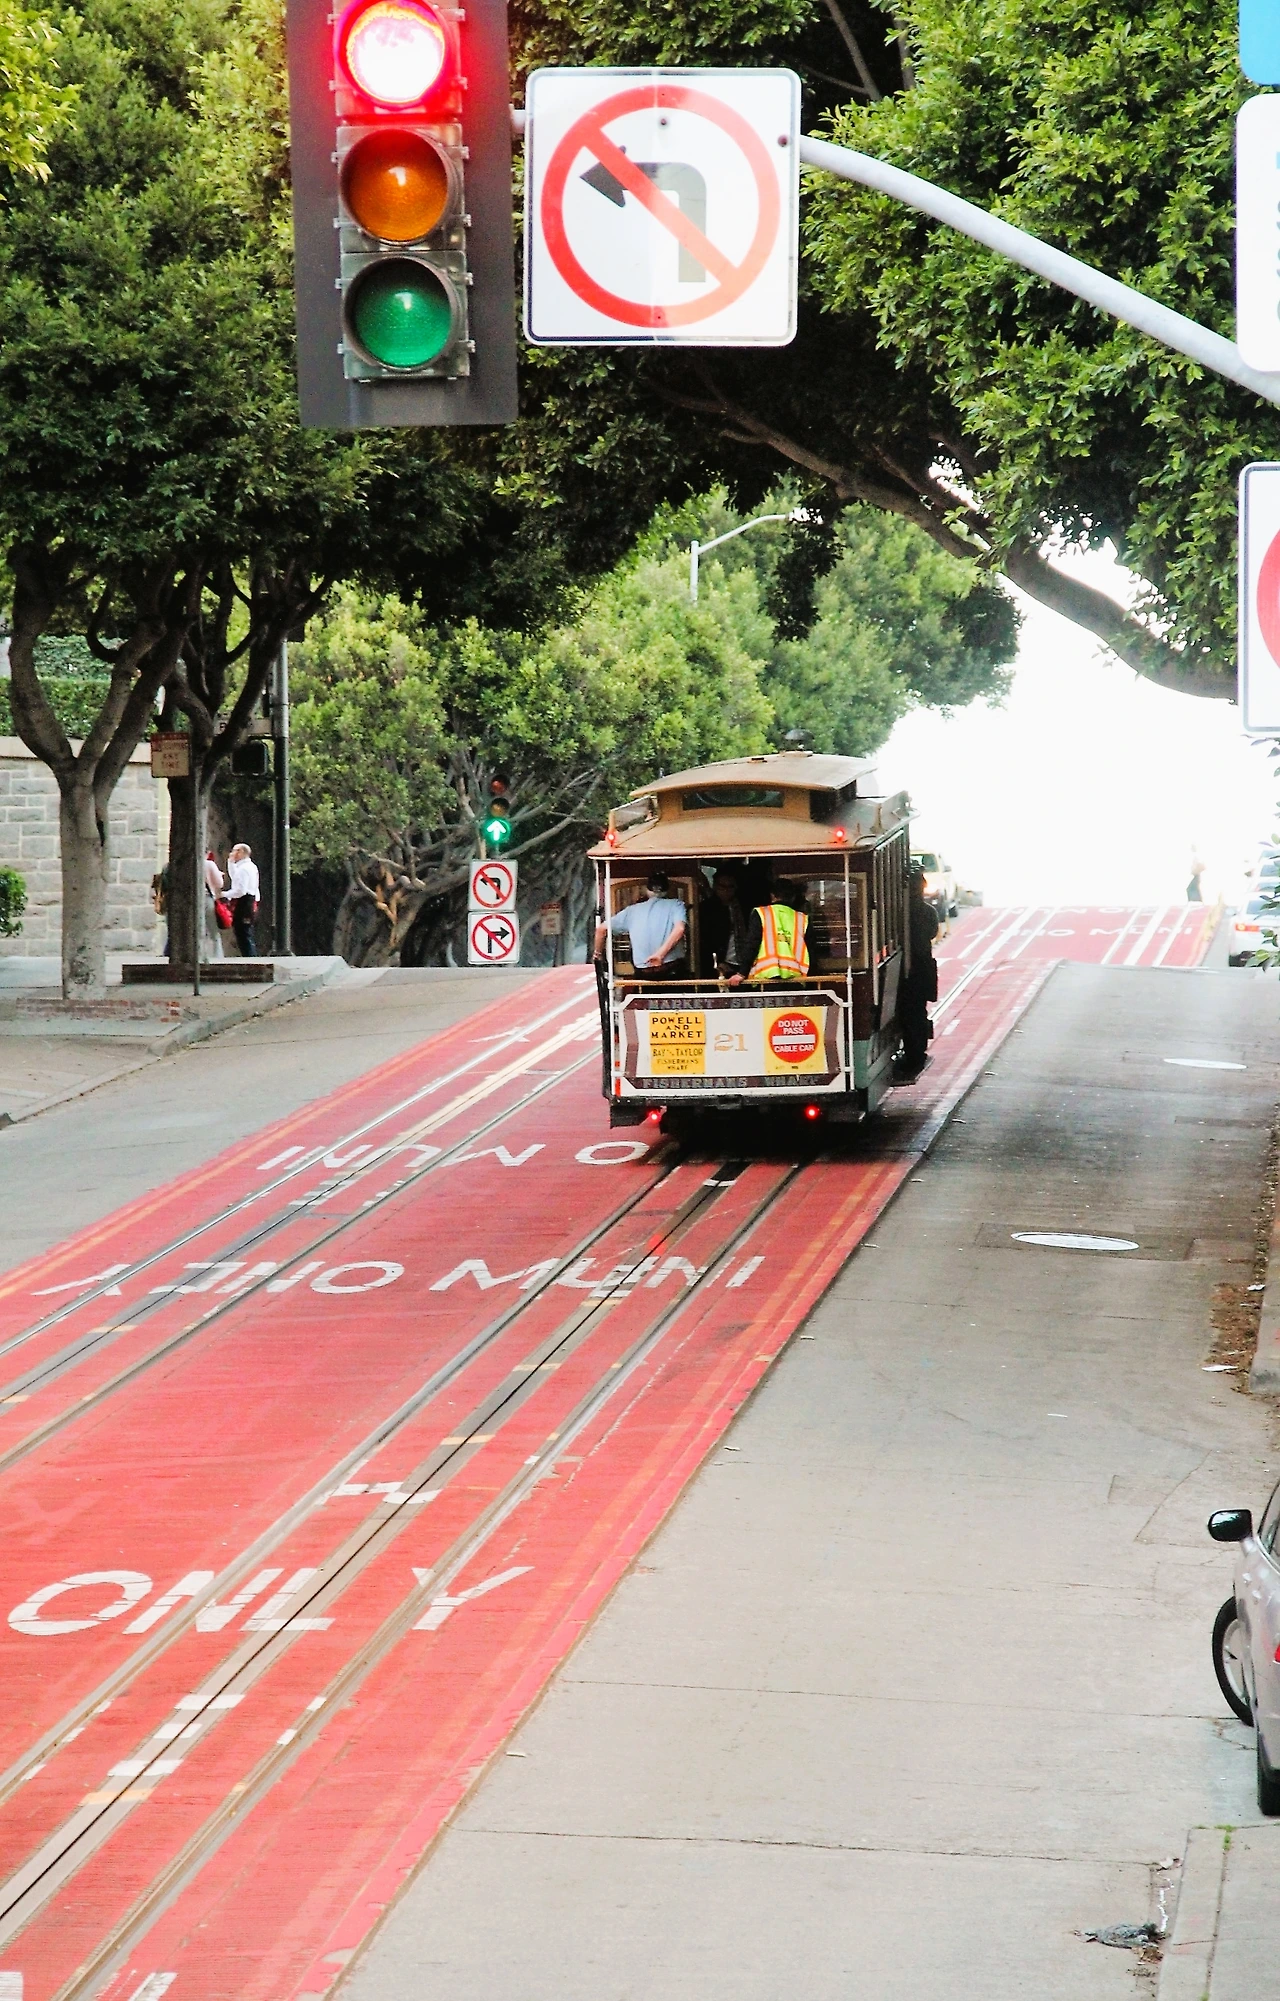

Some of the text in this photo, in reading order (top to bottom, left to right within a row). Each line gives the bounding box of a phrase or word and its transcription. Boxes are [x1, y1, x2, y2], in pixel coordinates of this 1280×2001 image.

[649, 999, 713, 1010] MARKET
[731, 997, 796, 1008] STREET
[652, 1017, 702, 1025] POWELL
[778, 1019, 809, 1028] DO NOT
[651, 1031, 703, 1039] MARKET
[783, 1027, 804, 1035] PASS
[714, 1032, 748, 1052] 21
[653, 1048, 666, 1057] BAY
[676, 1048, 703, 1056] TAYLOR
[774, 1044, 814, 1053] CABLE CAR
[643, 1077, 748, 1089] FISHERMANS
[7, 1562, 535, 1637] ONLY
